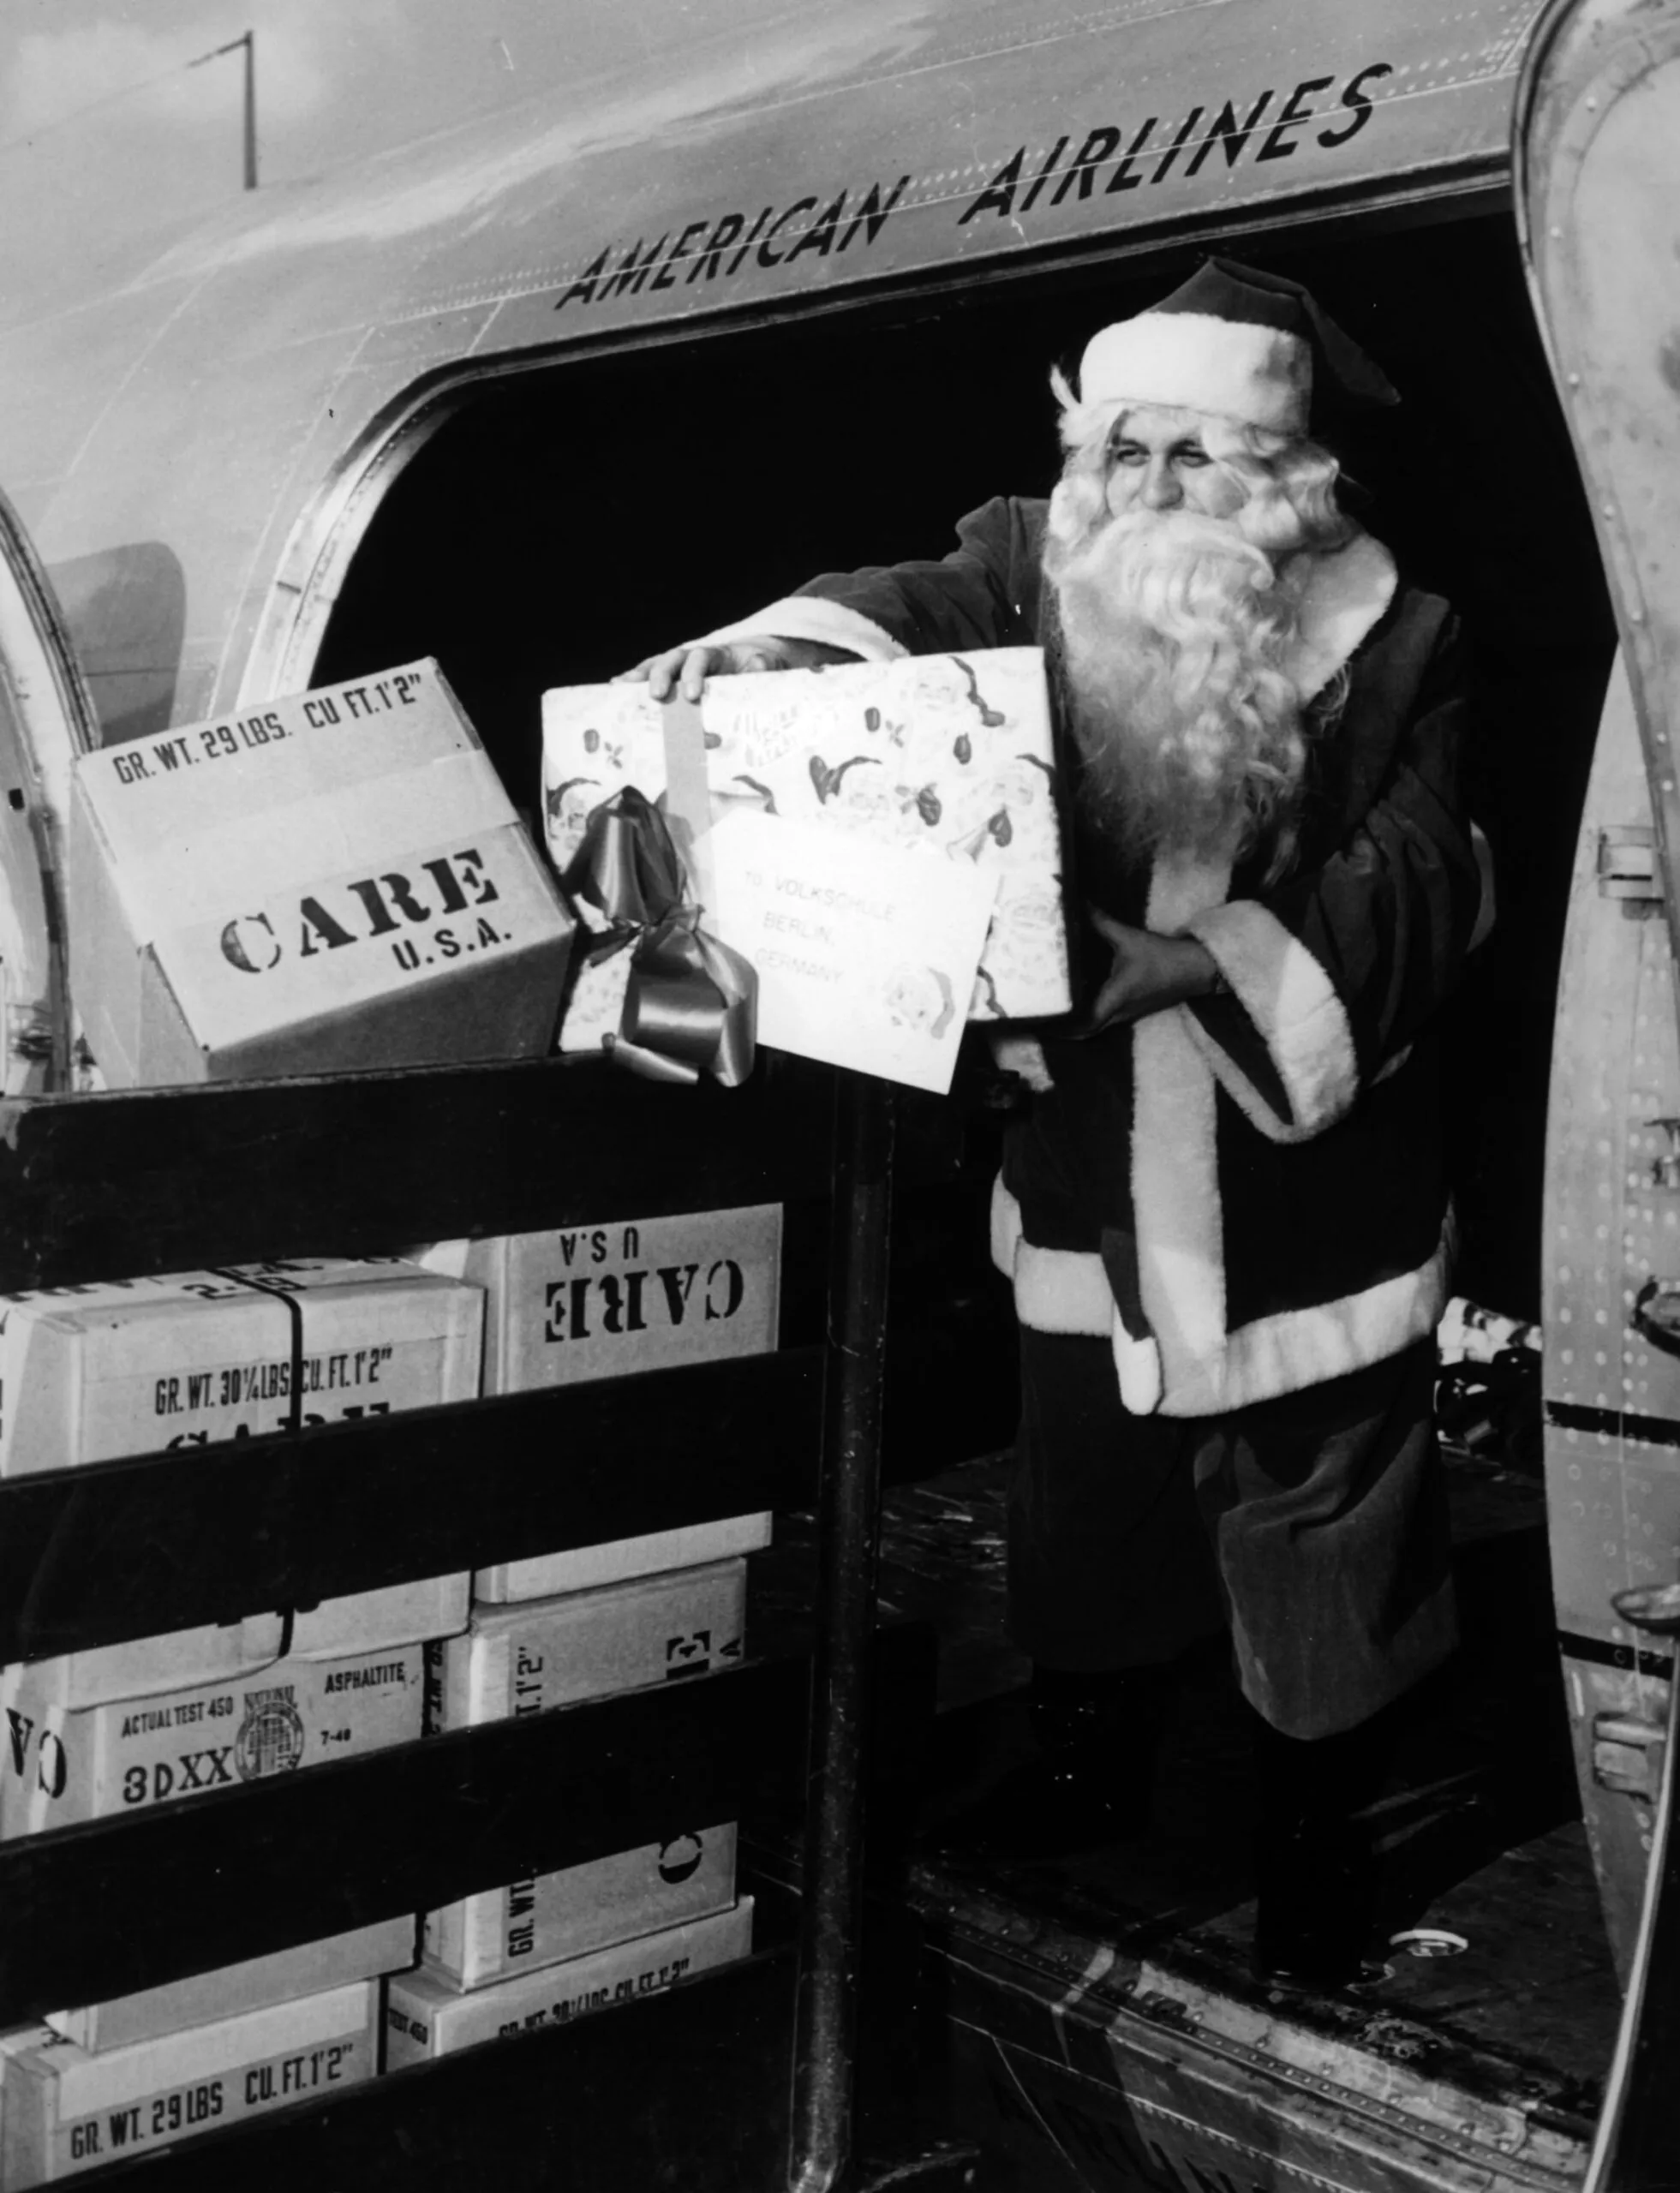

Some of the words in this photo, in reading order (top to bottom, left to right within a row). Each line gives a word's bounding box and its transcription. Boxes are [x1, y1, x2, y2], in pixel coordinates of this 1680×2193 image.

[554, 175, 911, 310] AMERICAN
[957, 63, 1393, 224] AIRLINES
[112, 751, 157, 784] GR.
[153, 738, 200, 771] WT.
[200, 726, 239, 758] 29
[237, 713, 292, 749] LBS.
[303, 697, 341, 728] CU
[220, 849, 499, 973] CARE
[392, 918, 511, 971] U.S.A.
[754, 947, 845, 985] GERMANY
[545, 1259, 744, 1343] CARE
[155, 1377, 184, 1414] GR.
[188, 1373, 215, 1410] WT.
[325, 1661, 406, 1695] ASPHALTITE
[121, 1708, 172, 1738] ACTUAL
[174, 1701, 205, 1725] TEST
[207, 1695, 234, 1718] 450
[507, 1918, 535, 1958] GR.
[70, 2120, 104, 2160] GR.
[110, 2106, 144, 2148] WT.
[152, 2094, 182, 2134] 29
[186, 2081, 223, 2124] LBS
[245, 2065, 278, 2105] CU.
